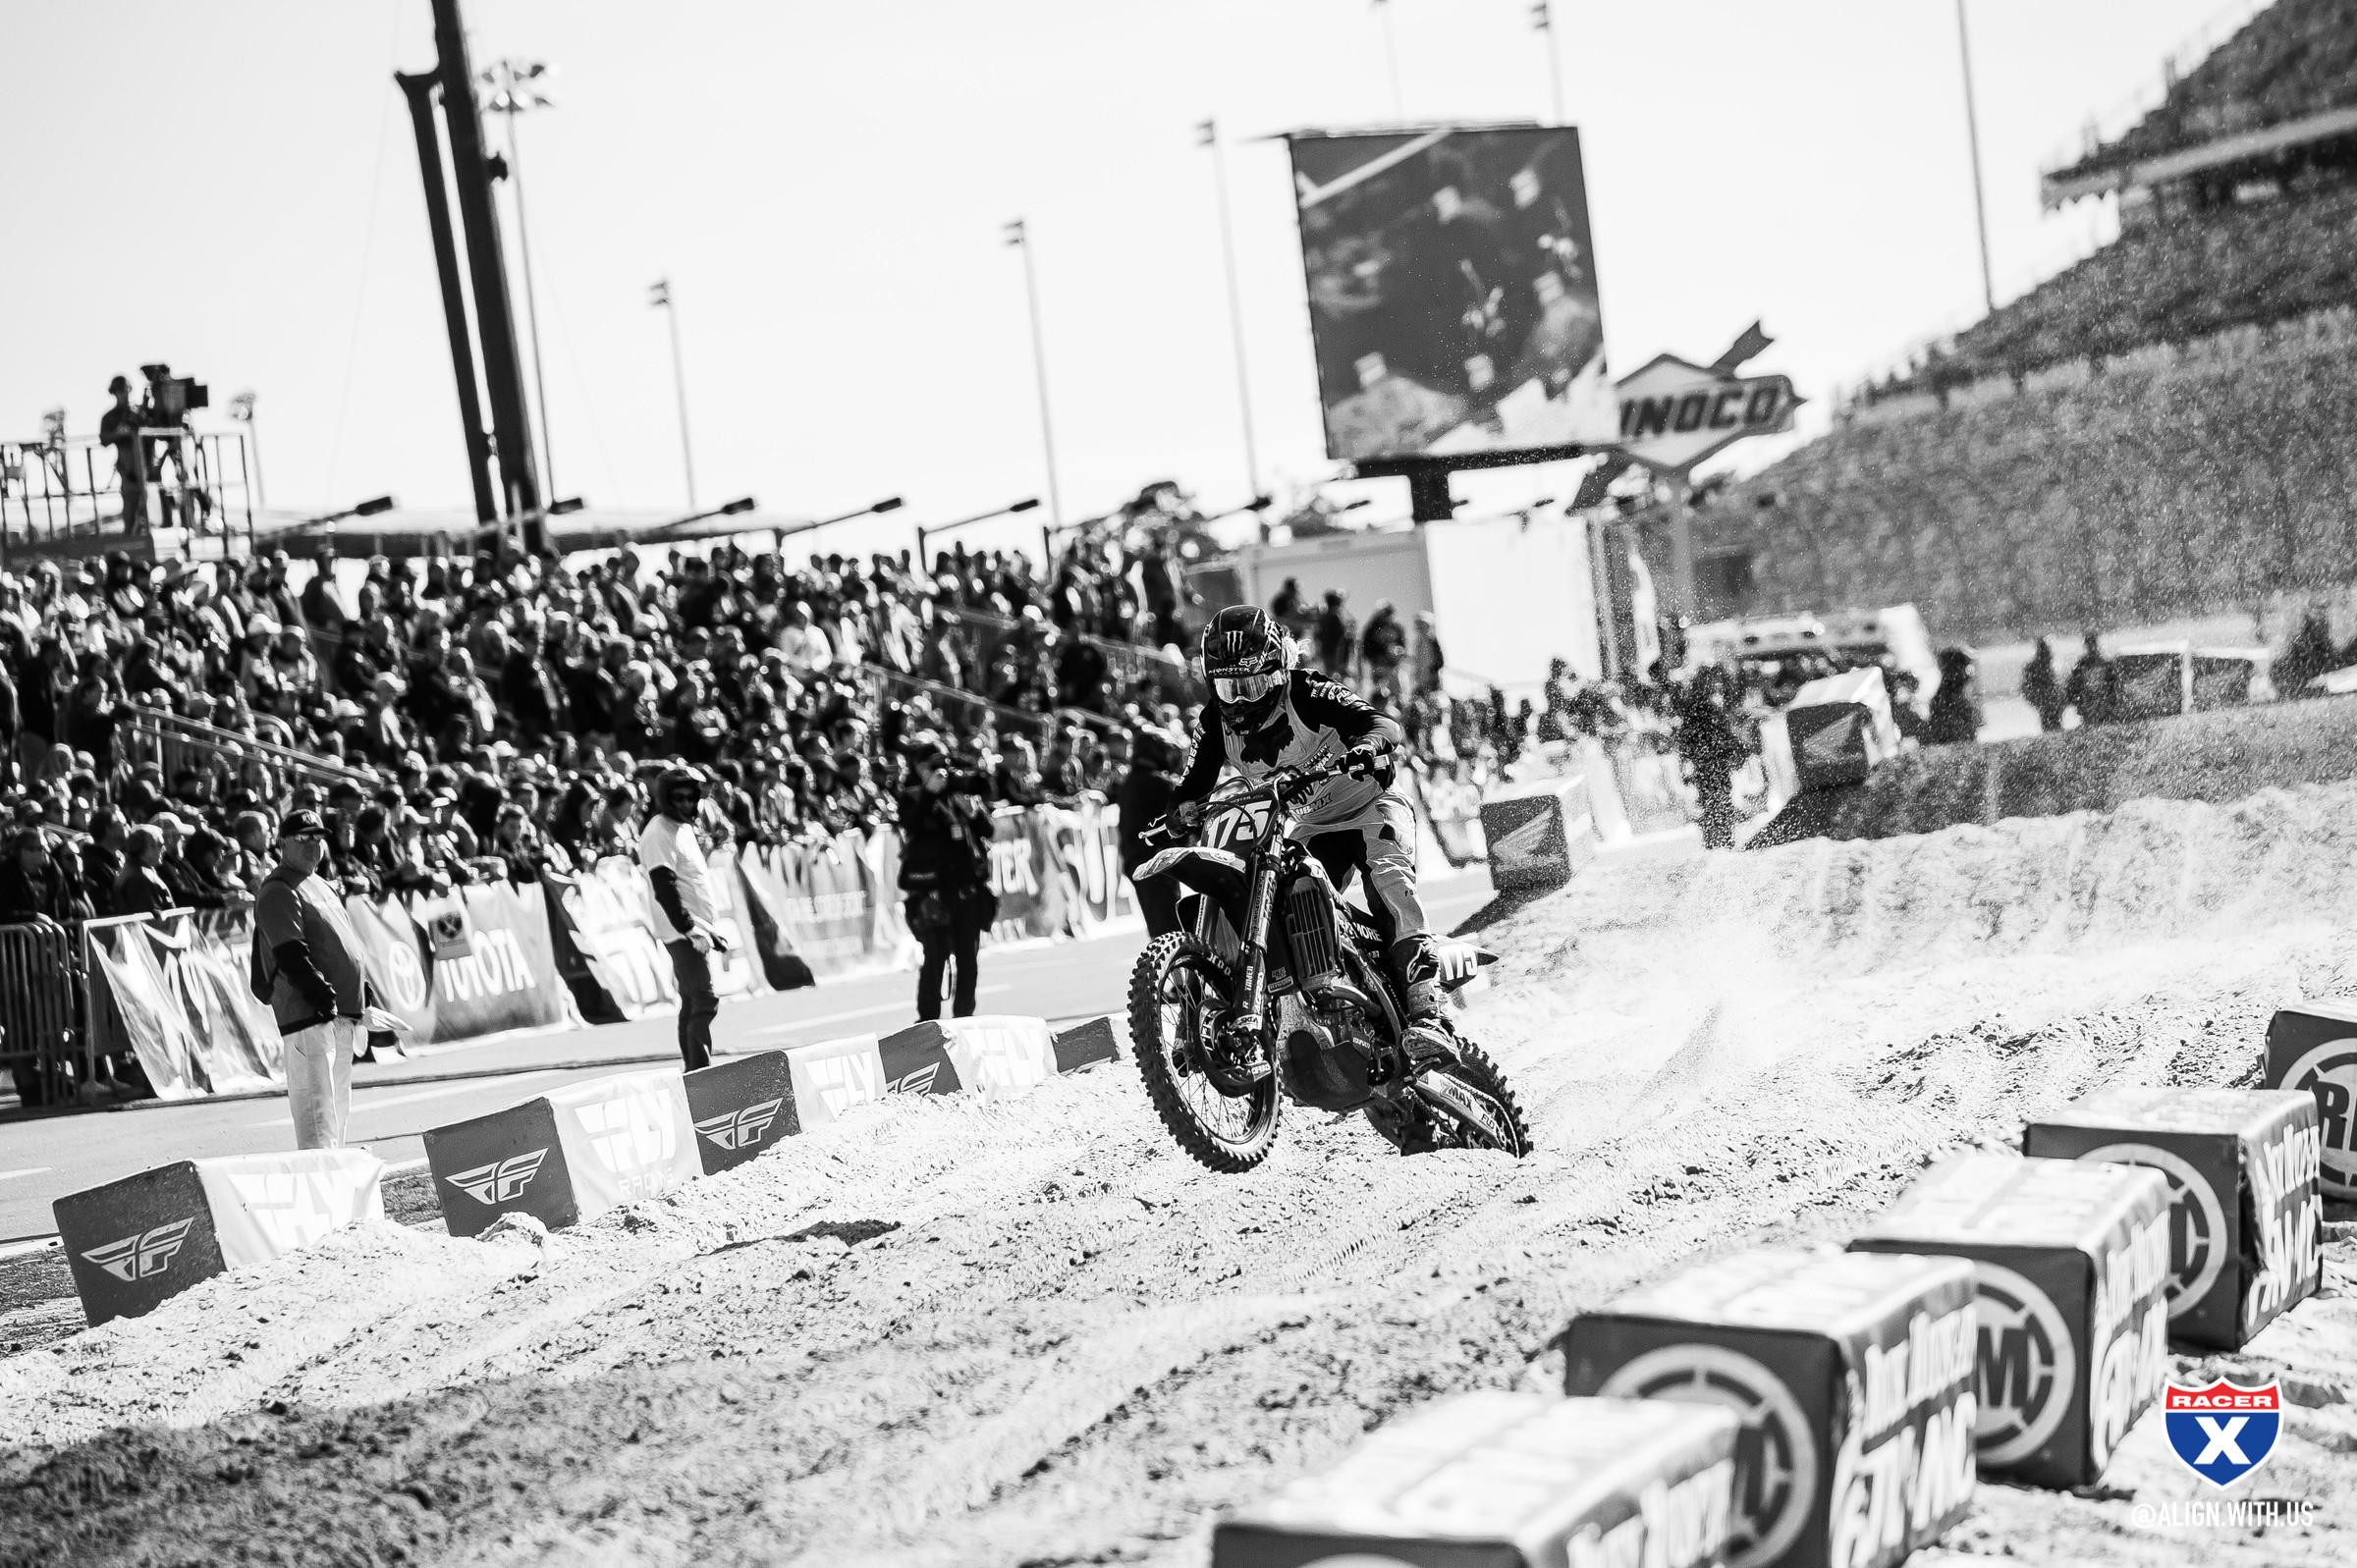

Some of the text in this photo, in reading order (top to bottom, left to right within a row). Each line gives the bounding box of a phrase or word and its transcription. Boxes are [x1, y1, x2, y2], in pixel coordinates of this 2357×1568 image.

[1207, 800, 1272, 849] 175
[804, 1051, 877, 1119] FLY
[574, 1087, 677, 1173] FLY
